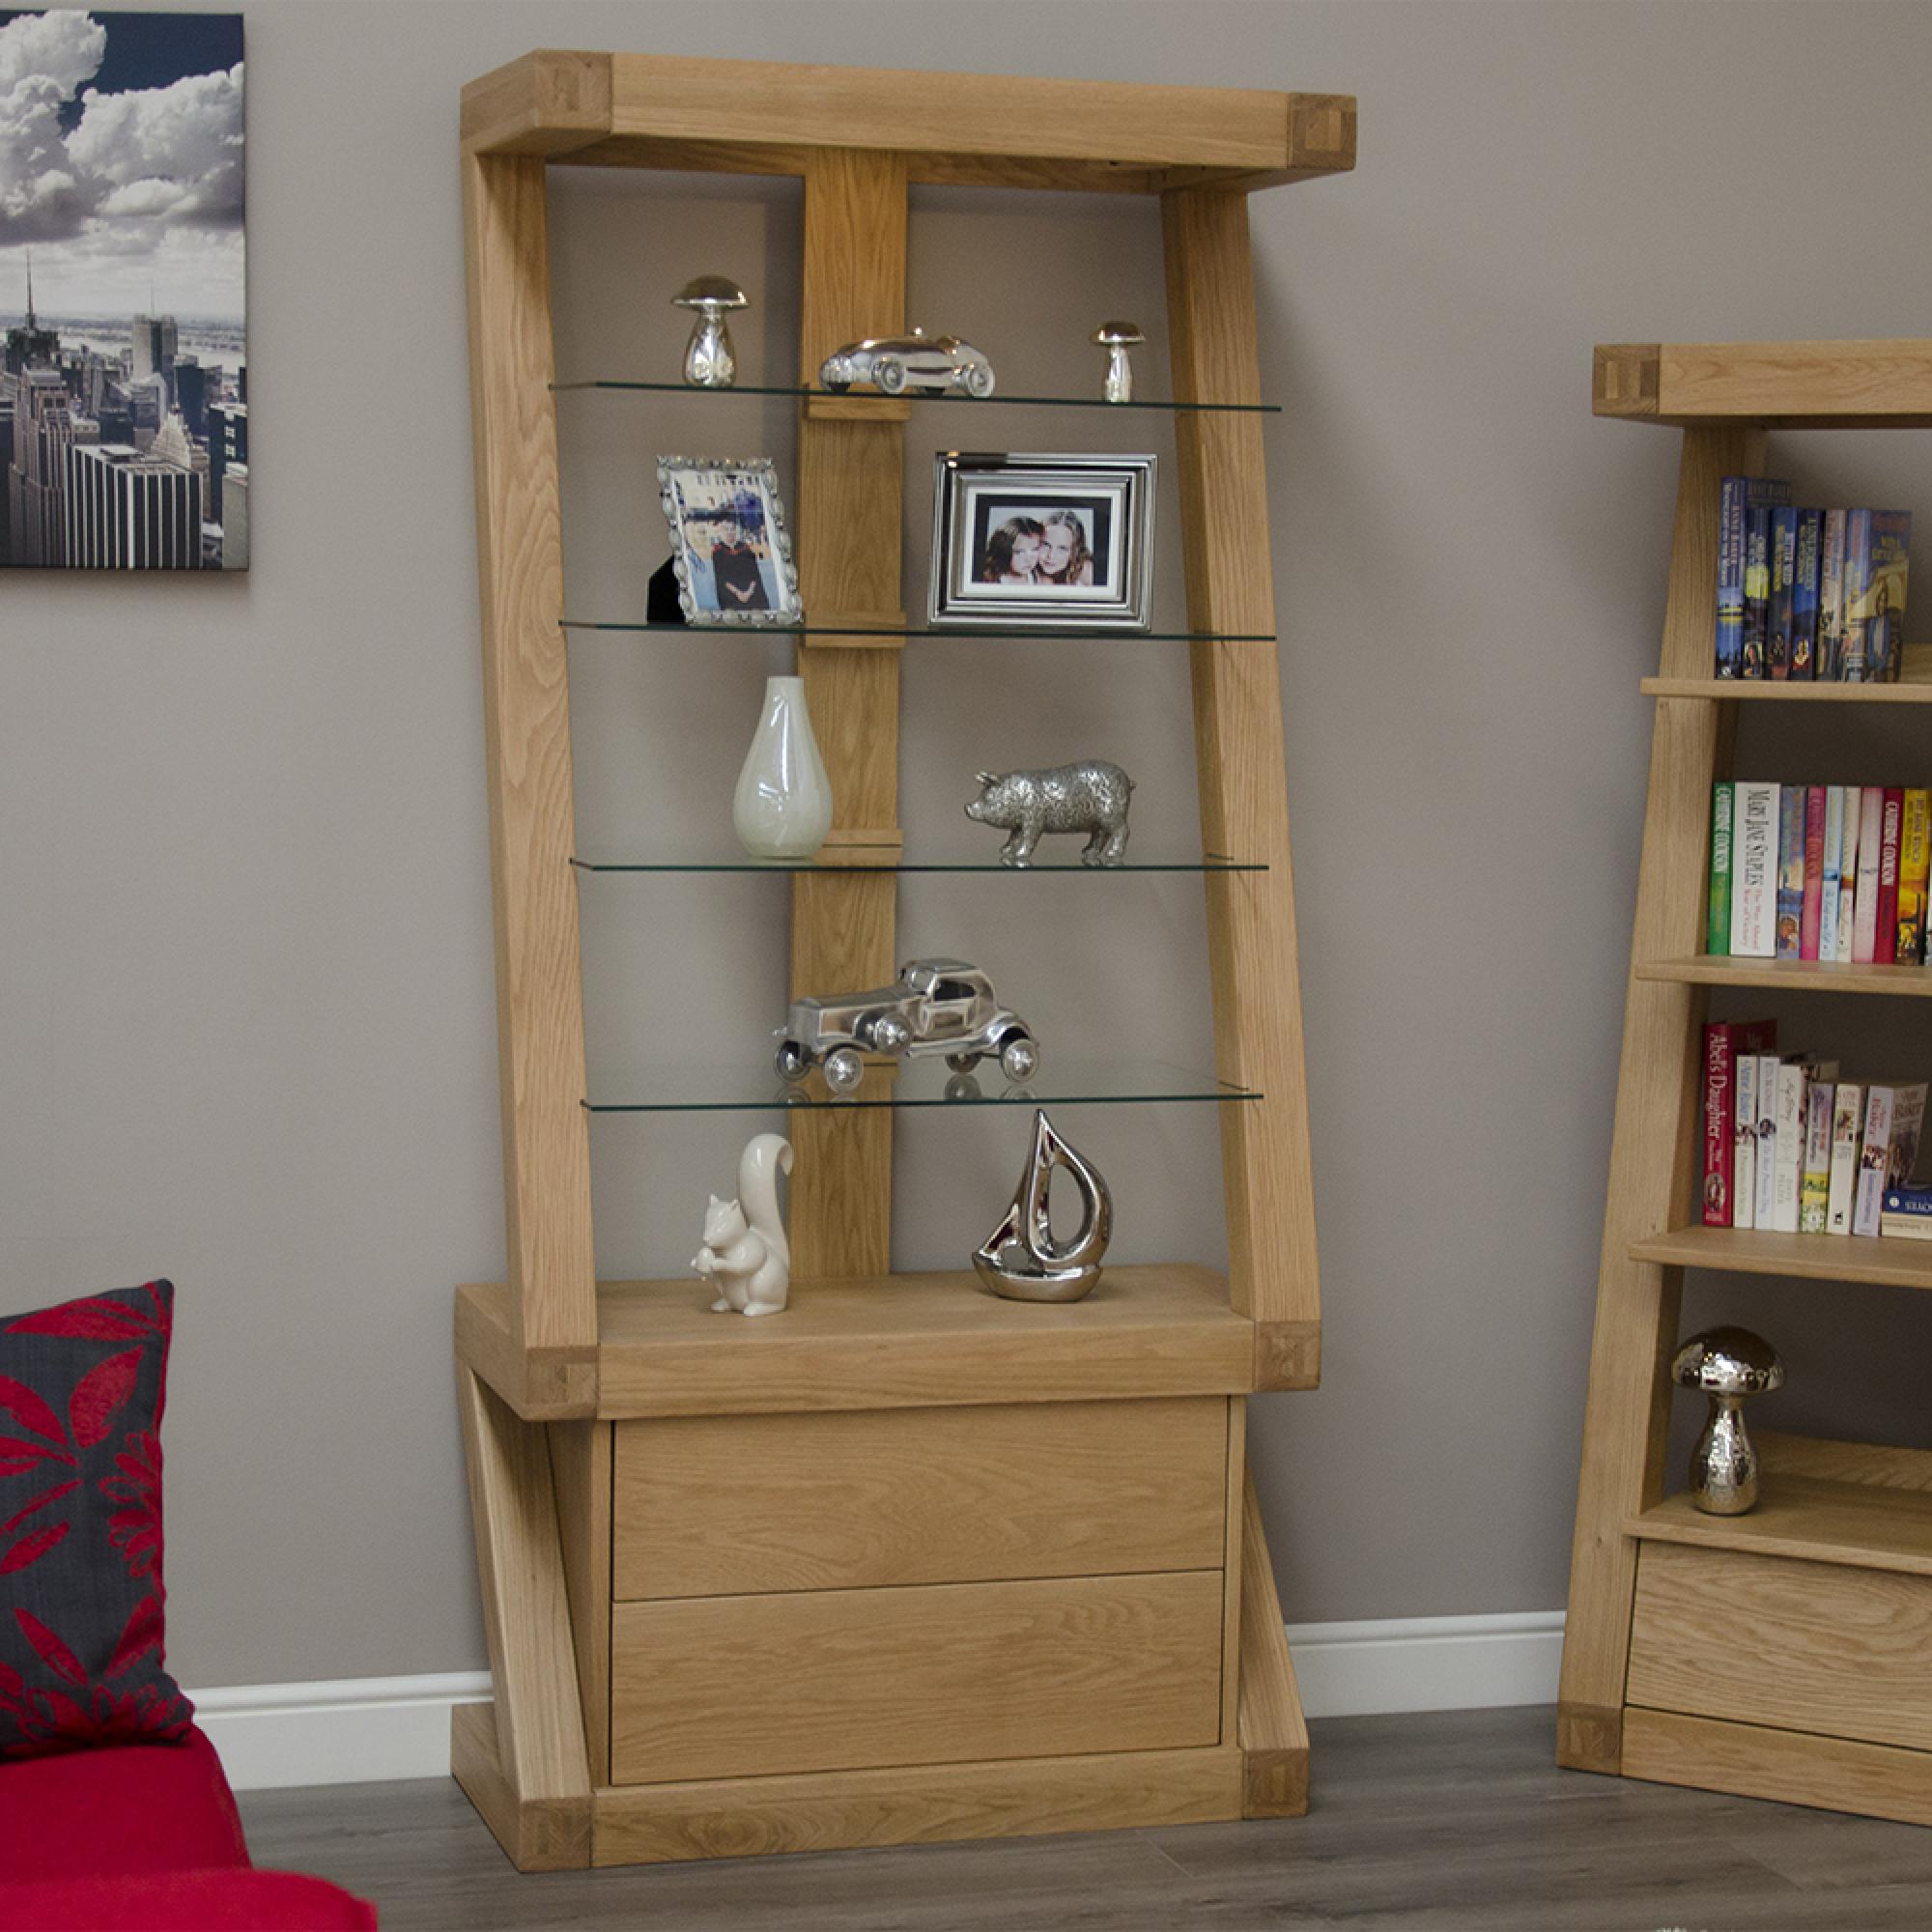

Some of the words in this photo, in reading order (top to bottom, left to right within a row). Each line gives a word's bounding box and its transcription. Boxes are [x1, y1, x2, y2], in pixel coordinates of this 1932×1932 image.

[1747, 789, 1771, 816] MARY
[1745, 818, 1770, 841] JANE
[1745, 843, 1768, 886] STAPLES
[1709, 1033, 1727, 1072] Abel's
[1706, 1075, 1727, 1139] Daughter
